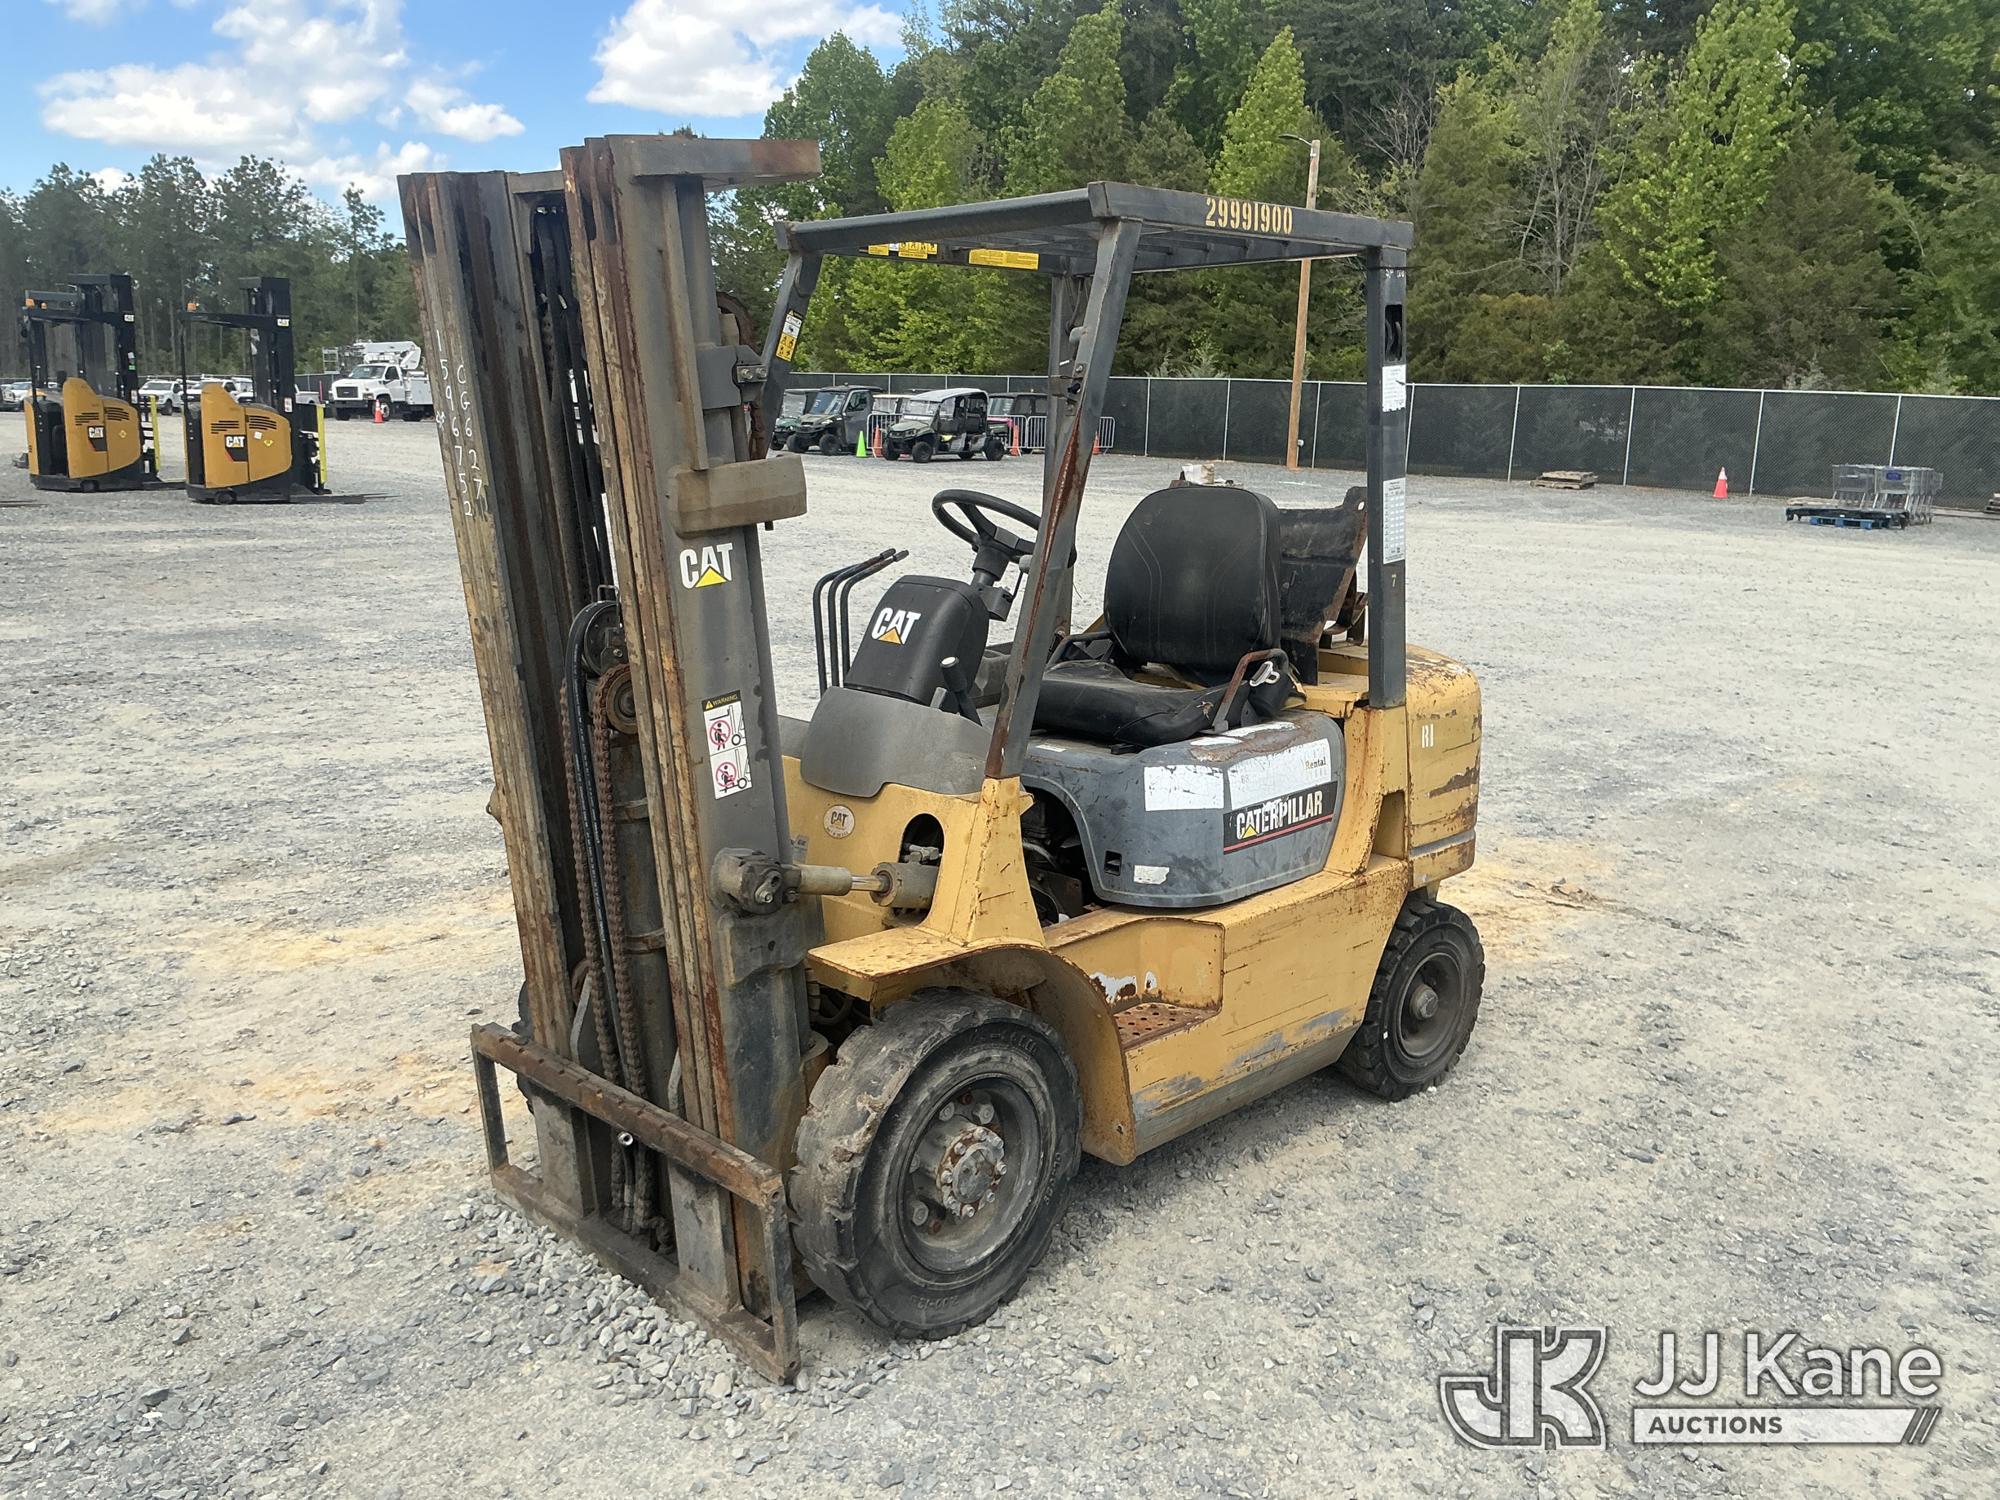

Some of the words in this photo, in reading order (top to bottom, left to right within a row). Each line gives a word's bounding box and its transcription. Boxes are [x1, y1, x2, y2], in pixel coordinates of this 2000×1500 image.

[1205, 197, 1293, 234] 29991900
[225, 436, 246, 448] CAT
[680, 543, 733, 589] CAT
[871, 607, 922, 645] CAT
[1304, 756, 1327, 770] Rental
[830, 811, 849, 827] CAT
[1236, 790, 1323, 840] CATERPILLAR
